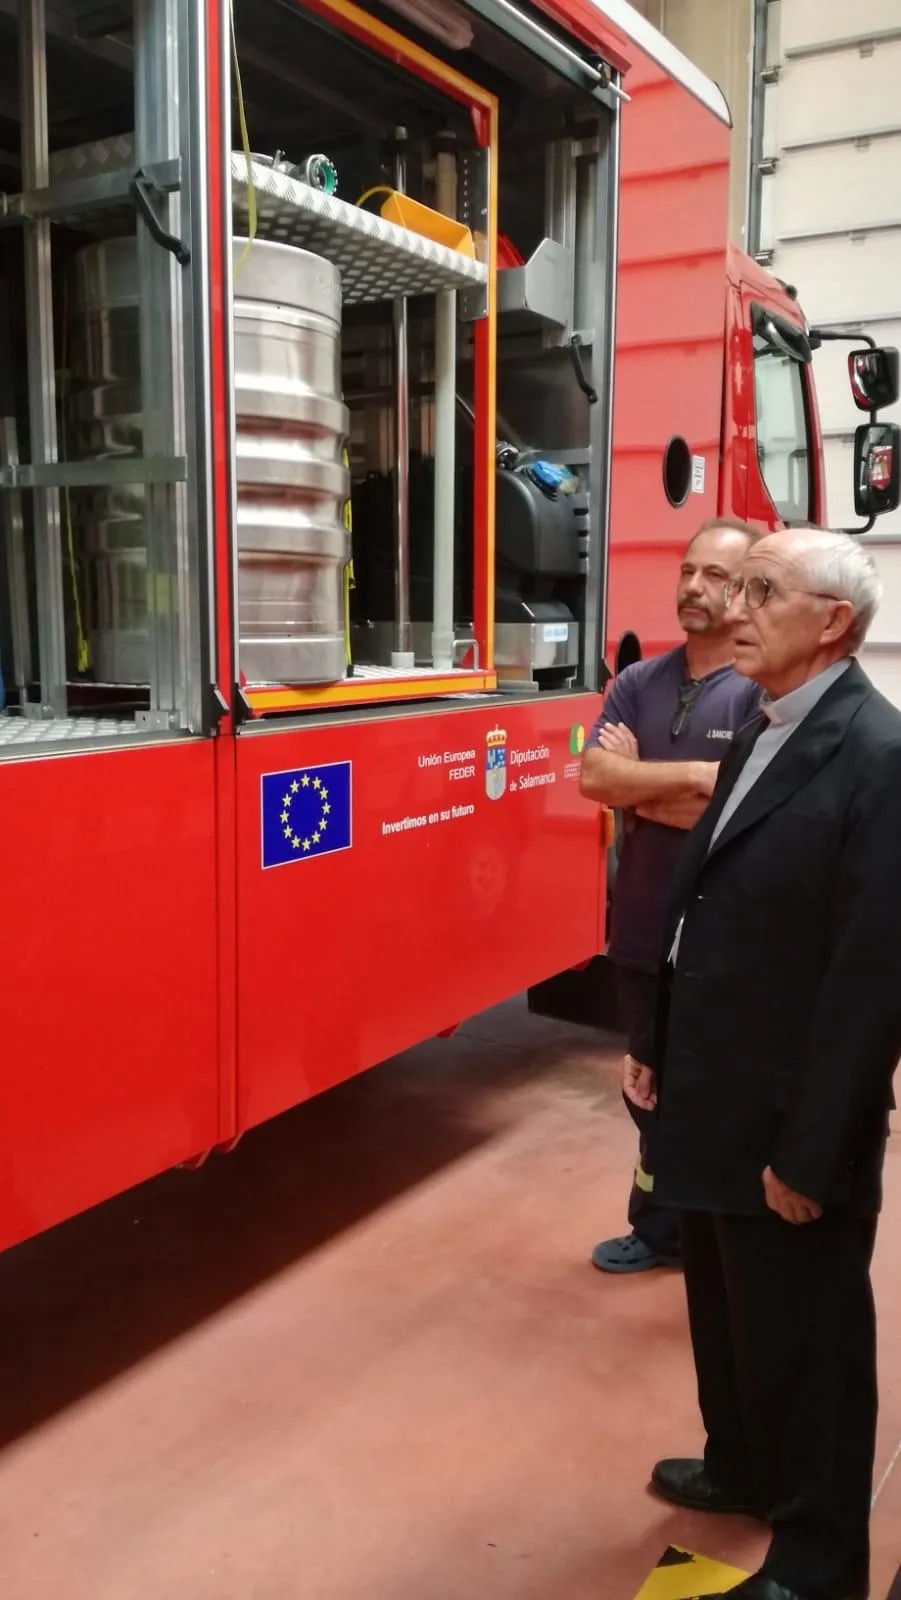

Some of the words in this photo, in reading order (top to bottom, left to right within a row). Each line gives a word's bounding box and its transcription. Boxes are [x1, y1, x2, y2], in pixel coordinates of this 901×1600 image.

[711, 729, 734, 740] SANCHE
[418, 754, 442, 768] Unión
[443, 749, 476, 763] Europea
[510, 744, 550, 767] Diputación
[449, 765, 476, 781] FEDER
[510, 780, 517, 792] de
[519, 772, 556, 790] Salamanca
[382, 816, 427, 836] Invertimos
[428, 812, 439, 825] en
[440, 810, 450, 821] su
[451, 804, 475, 818] futuro
